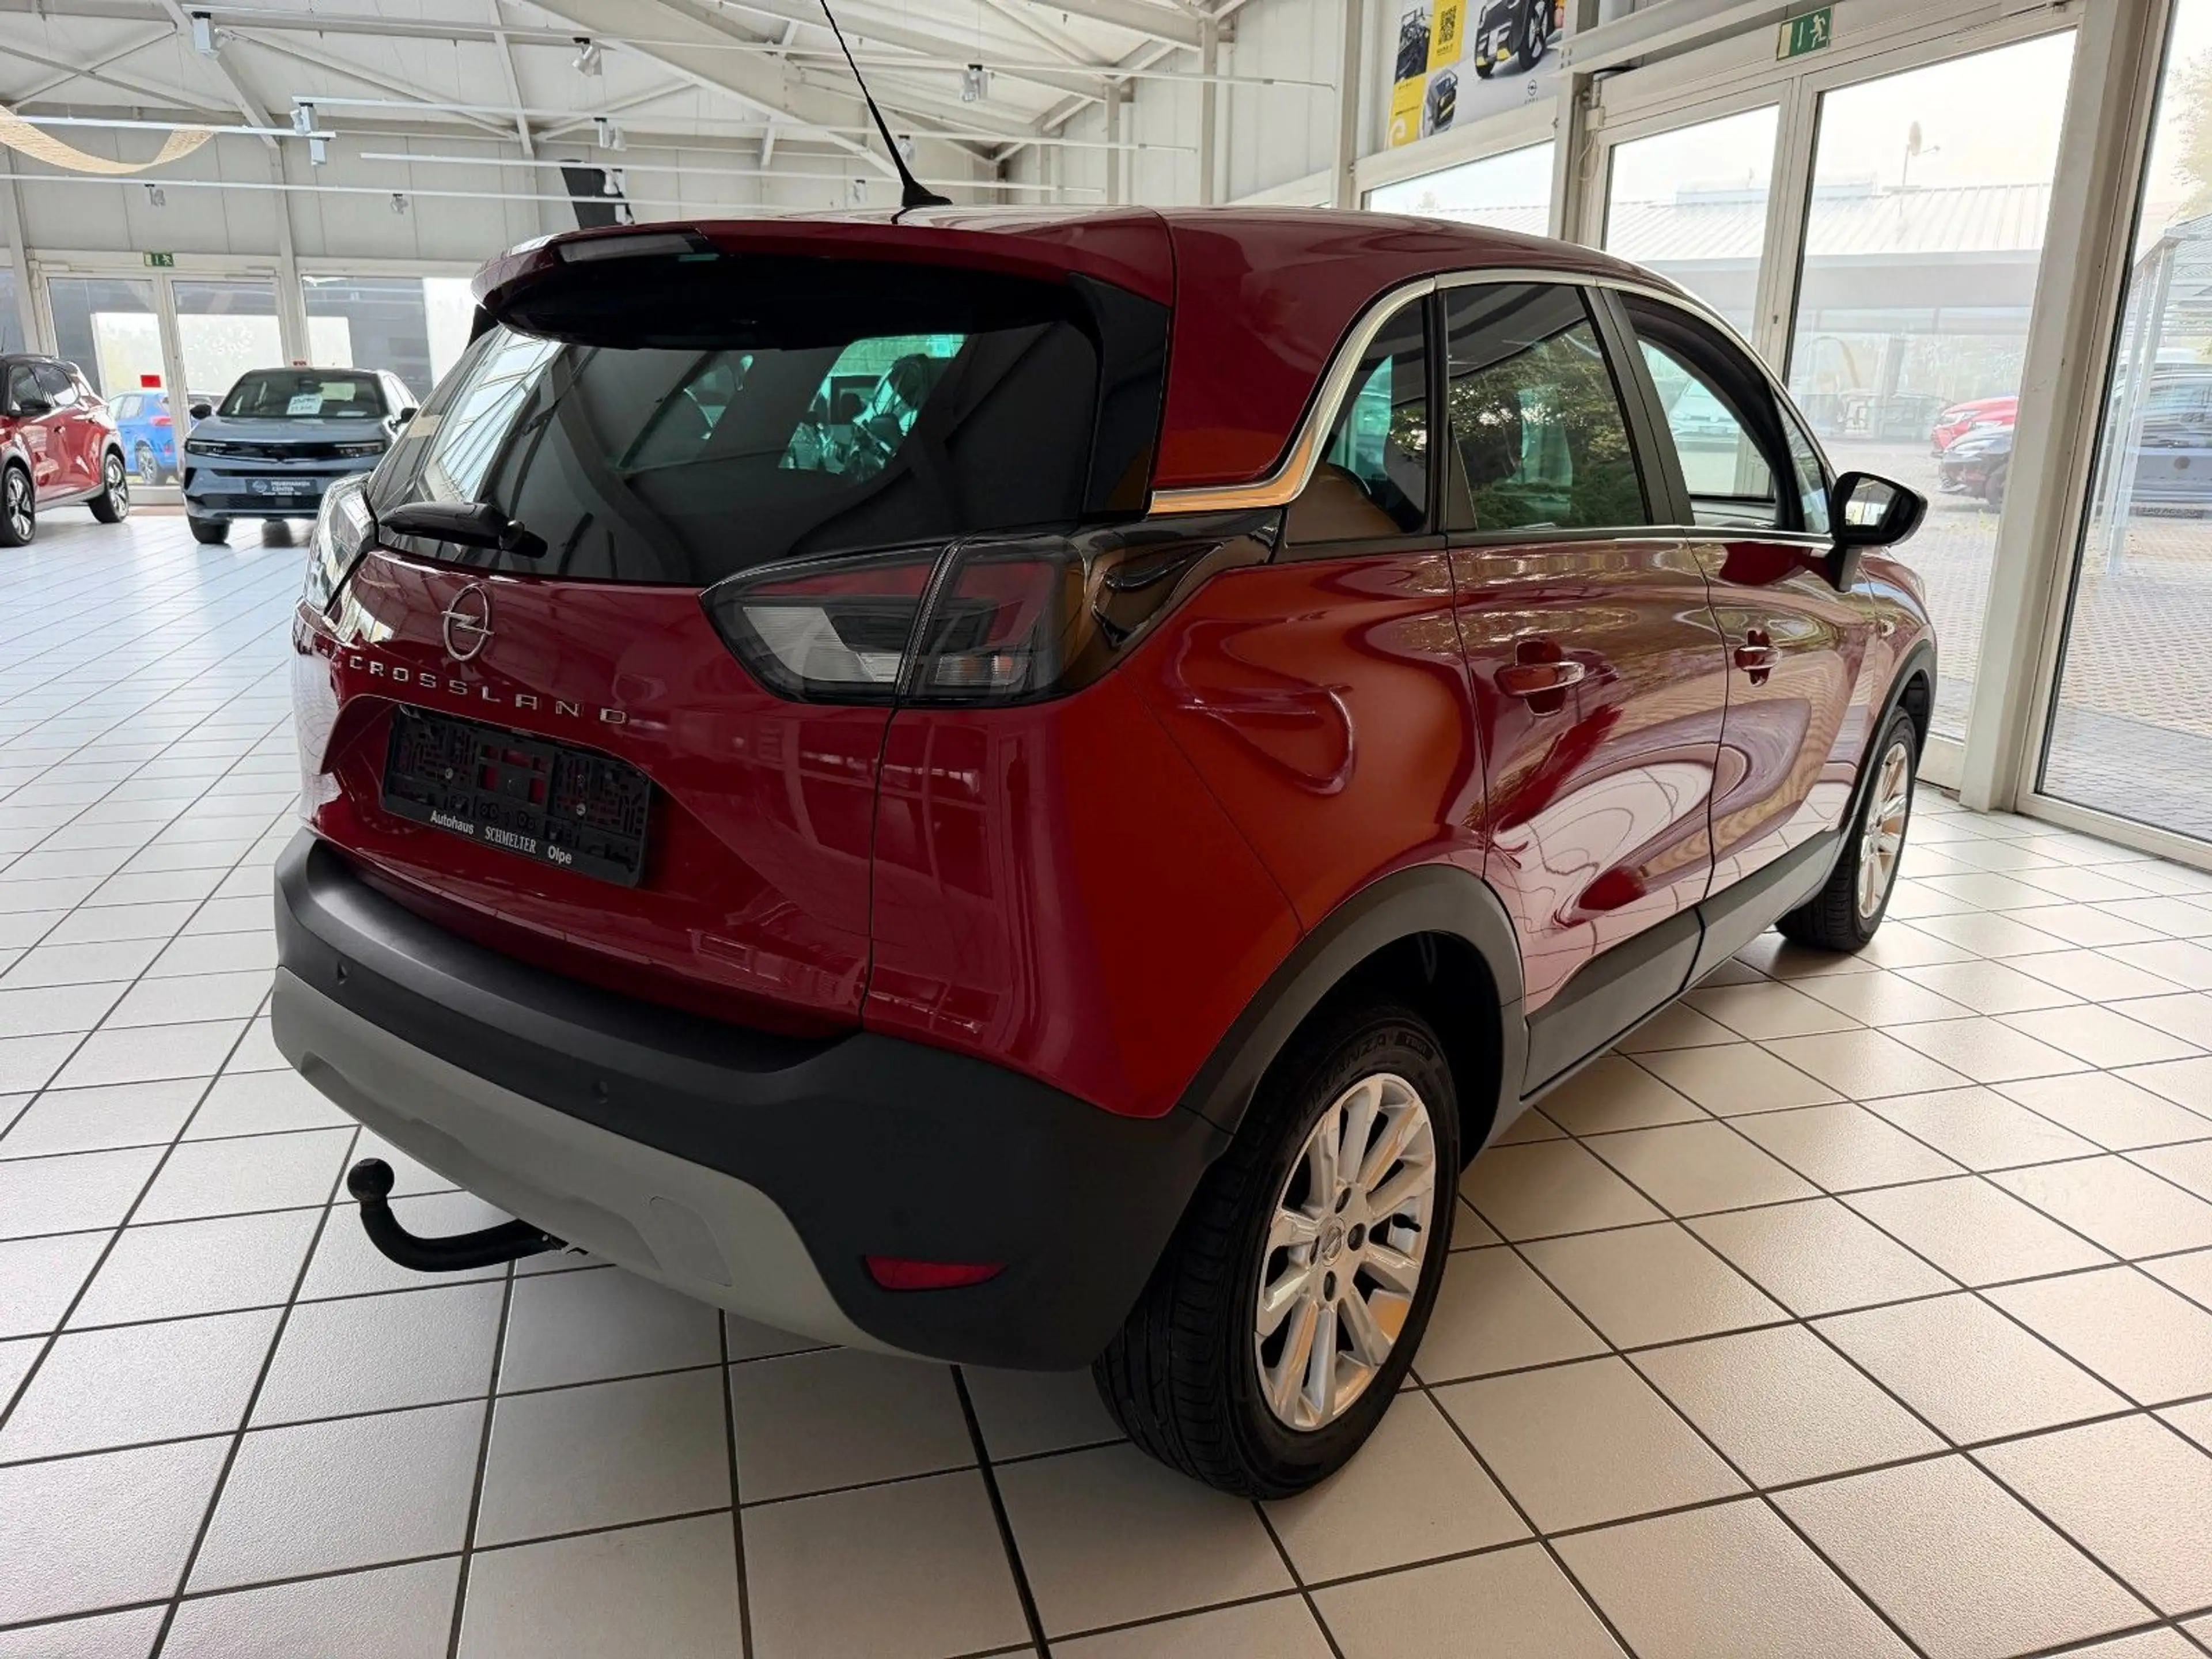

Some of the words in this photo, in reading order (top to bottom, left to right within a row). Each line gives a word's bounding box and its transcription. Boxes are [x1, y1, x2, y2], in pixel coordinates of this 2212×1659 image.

[349, 655, 627, 724] CROSSLAND
[430, 810, 474, 835] Autohaus
[484, 826, 537, 854] SCHMELTER
[548, 846, 572, 865] Olpe
